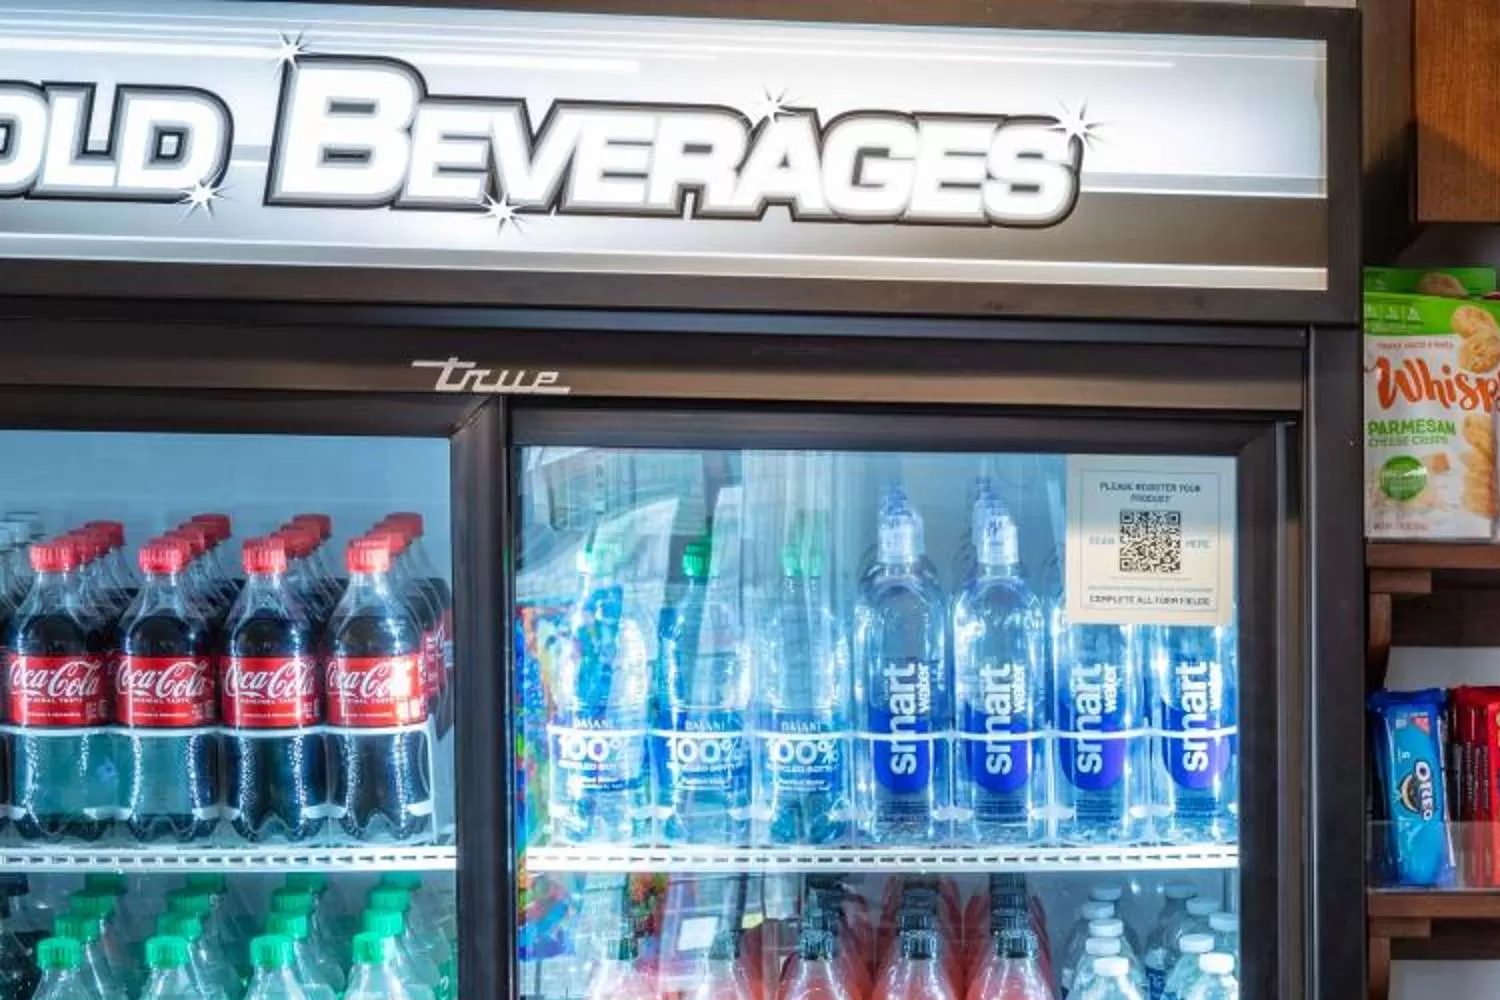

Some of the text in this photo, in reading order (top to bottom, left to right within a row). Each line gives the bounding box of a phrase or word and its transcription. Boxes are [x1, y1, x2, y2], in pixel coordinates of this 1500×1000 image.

[264, 55, 1084, 228] BEVERAGES
[1367, 418, 1456, 436] PARMESAN
[9, 660, 101, 697] Coca-Cola
[115, 660, 209, 698] Coca-Cola
[225, 660, 315, 698] Coca-Cola
[326, 660, 404, 698] Coca-Co
[884, 662, 917, 775] smart
[980, 663, 1013, 775] smart
[1072, 663, 1102, 775] smart
[1176, 660, 1208, 773] smart
